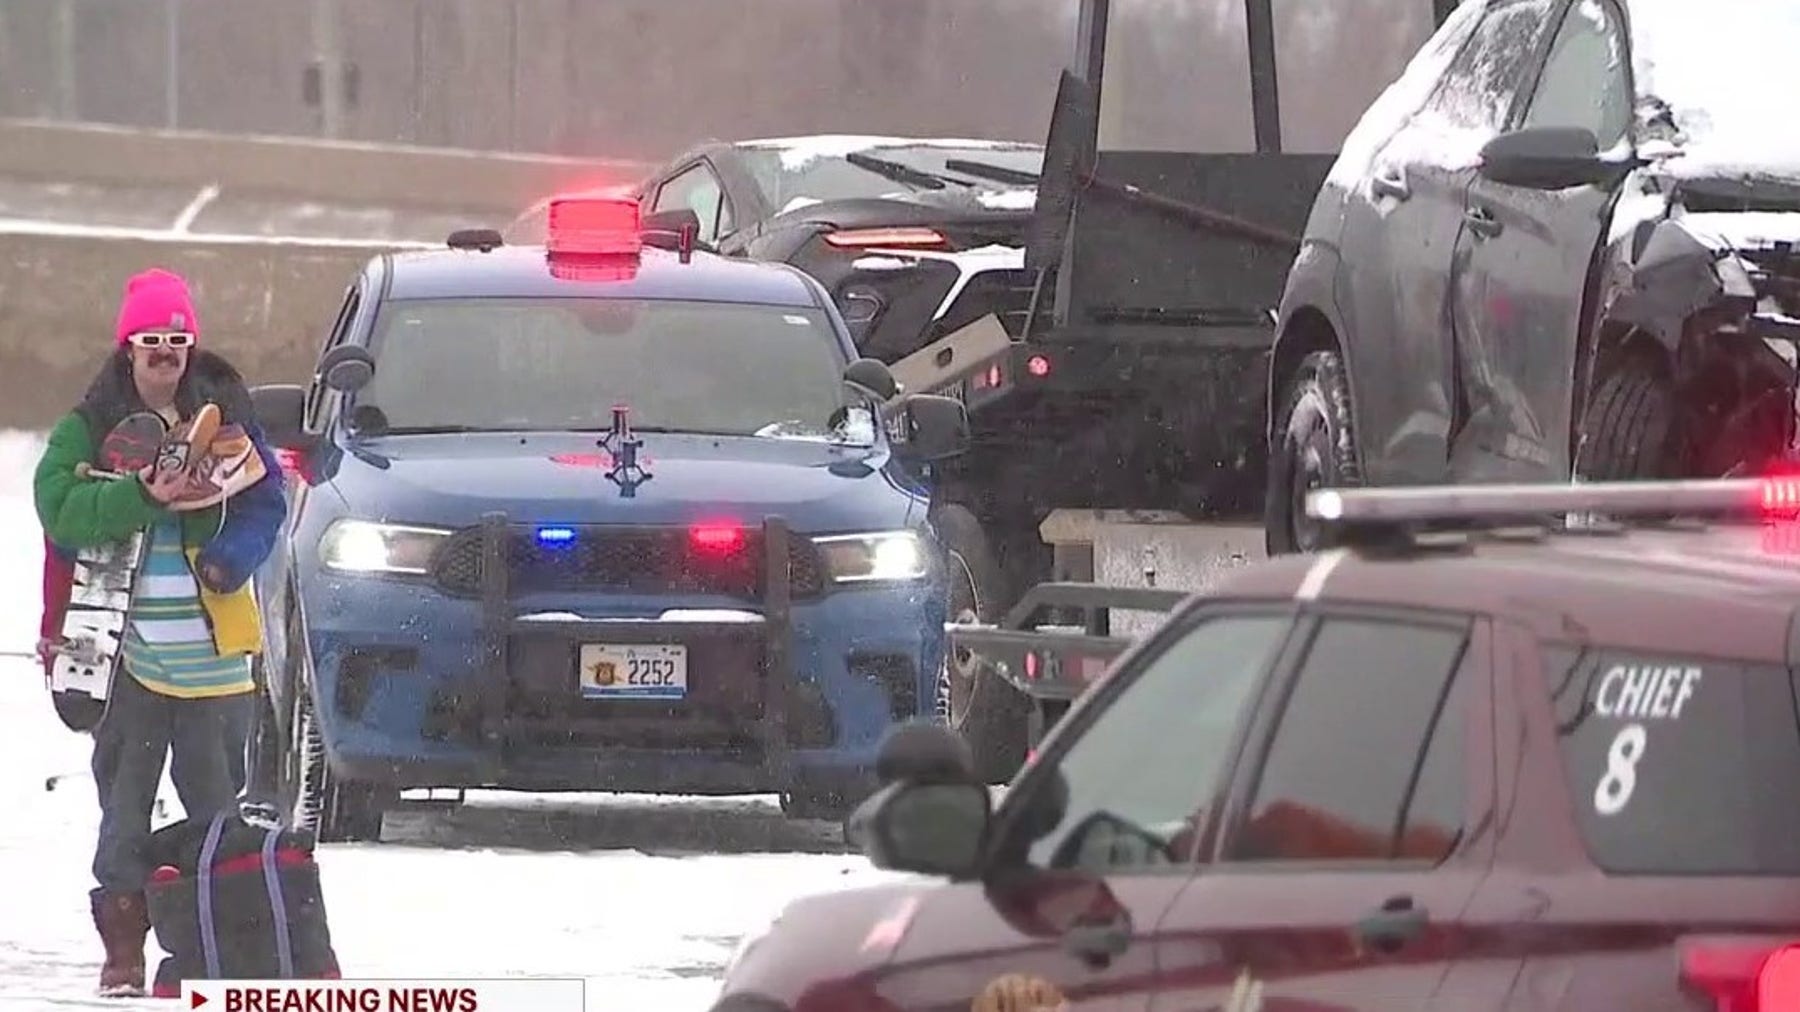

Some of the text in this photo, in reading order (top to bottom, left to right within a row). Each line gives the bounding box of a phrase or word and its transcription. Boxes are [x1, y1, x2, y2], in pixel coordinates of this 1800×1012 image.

[628, 659, 674, 685] 2252
[1597, 666, 1702, 718] CHIEF
[1594, 724, 1647, 815] 8
